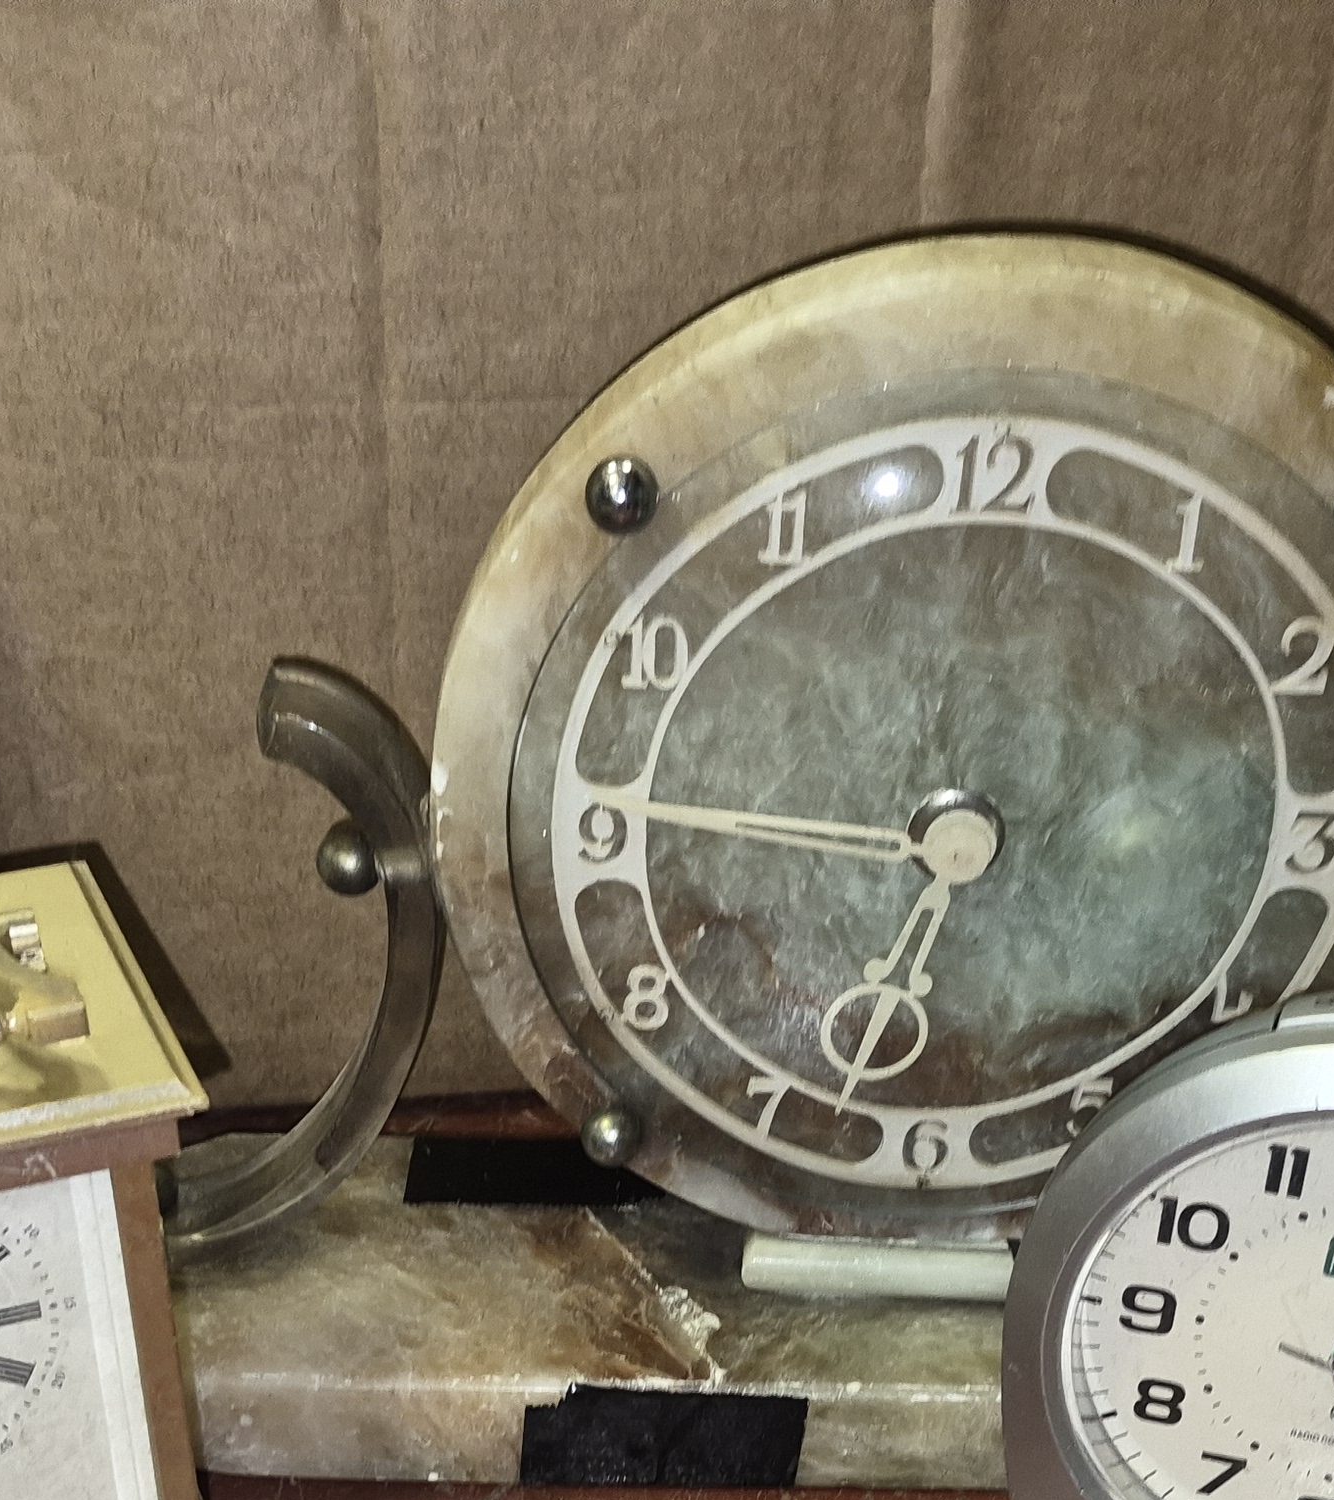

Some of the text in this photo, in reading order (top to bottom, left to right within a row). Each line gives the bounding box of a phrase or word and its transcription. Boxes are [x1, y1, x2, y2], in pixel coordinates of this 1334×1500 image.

[945, 433, 1037, 514] 12
[1165, 496, 1205, 573] 1
[620, 618, 689, 689] 10
[579, 805, 628, 863] 9
[622, 964, 670, 1031] 8
[746, 1075, 800, 1139] 7
[902, 1120, 949, 1178] 6
[1266, 1144, 1310, 1199] 11
[1156, 1197, 1229, 1252] 10
[1119, 1285, 1177, 1334] 9
[1133, 1378, 1185, 1425] 8
[1198, 1450, 1247, 1497] 7
